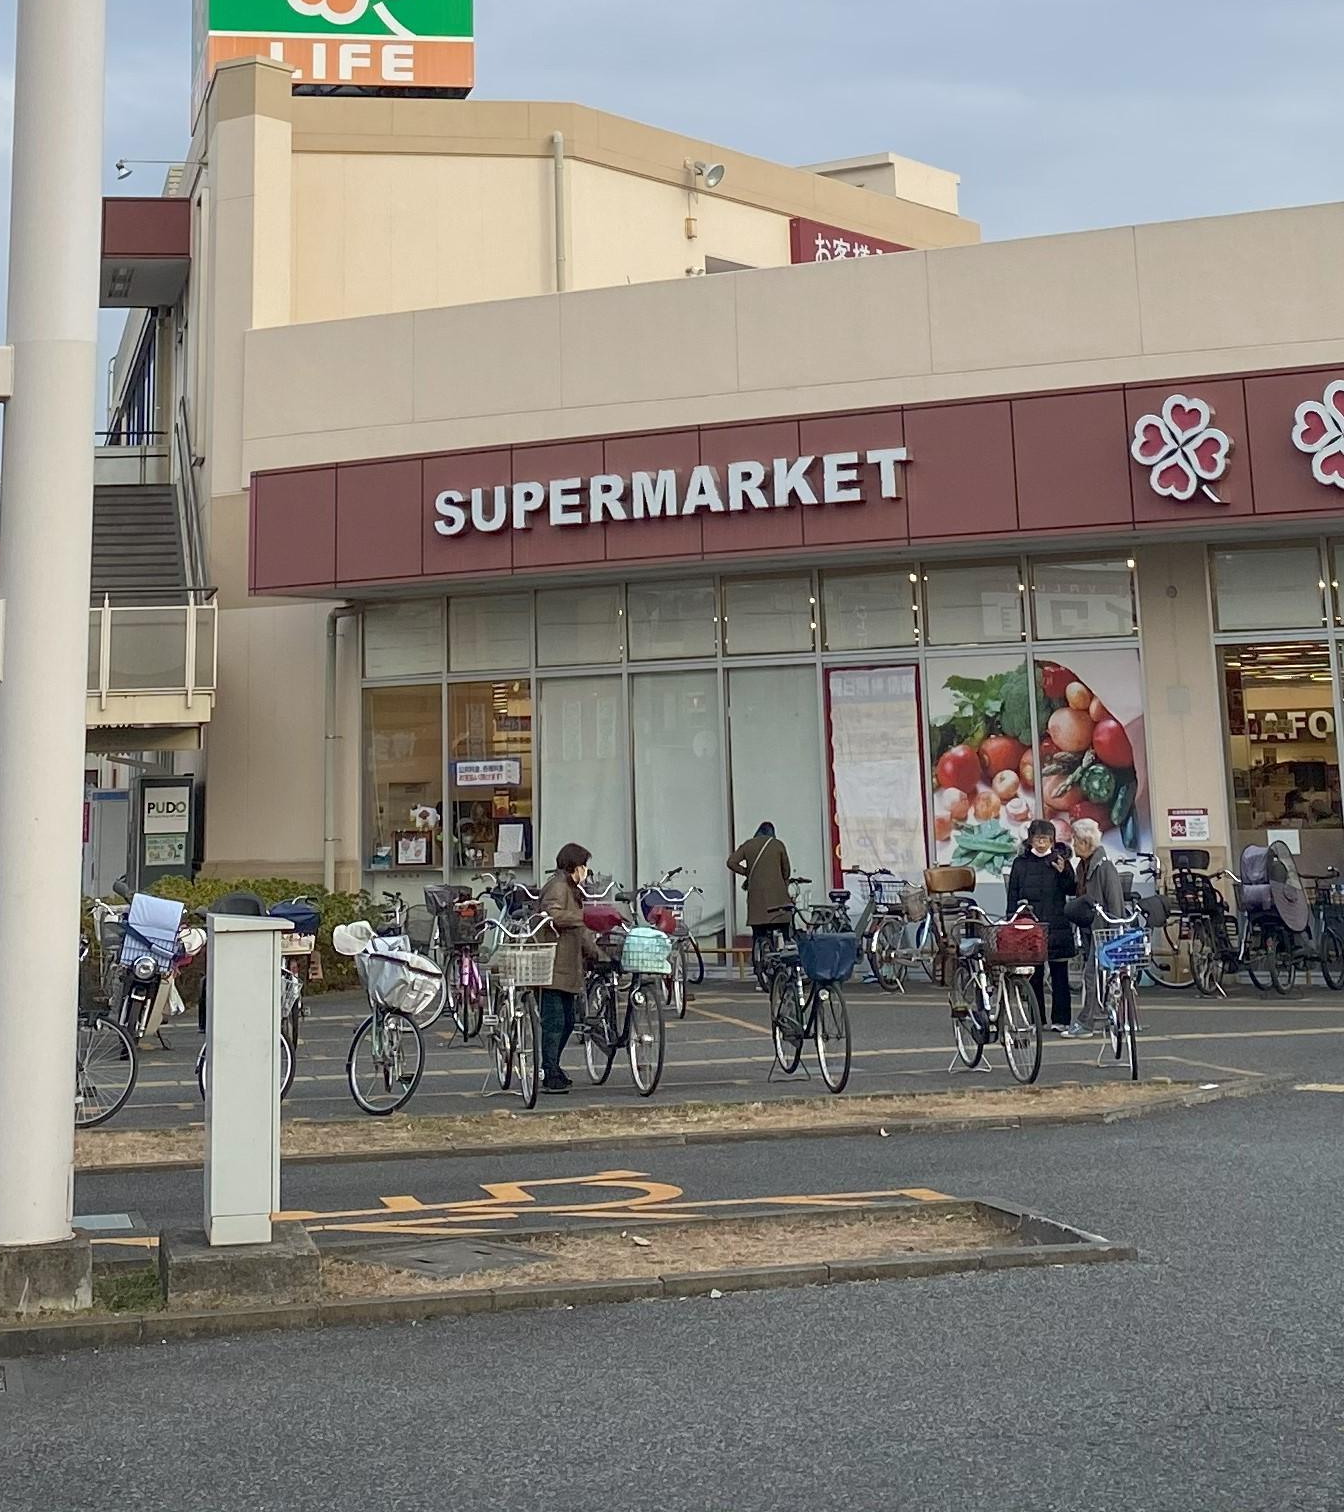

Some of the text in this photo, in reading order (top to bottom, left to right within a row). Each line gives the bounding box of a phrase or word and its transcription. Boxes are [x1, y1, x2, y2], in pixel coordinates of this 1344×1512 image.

[269, 40, 415, 82] LIFE
[815, 233, 883, 263] お客様
[434, 446, 909, 536] SUPERMARKET
[147, 801, 187, 814] PUDO
